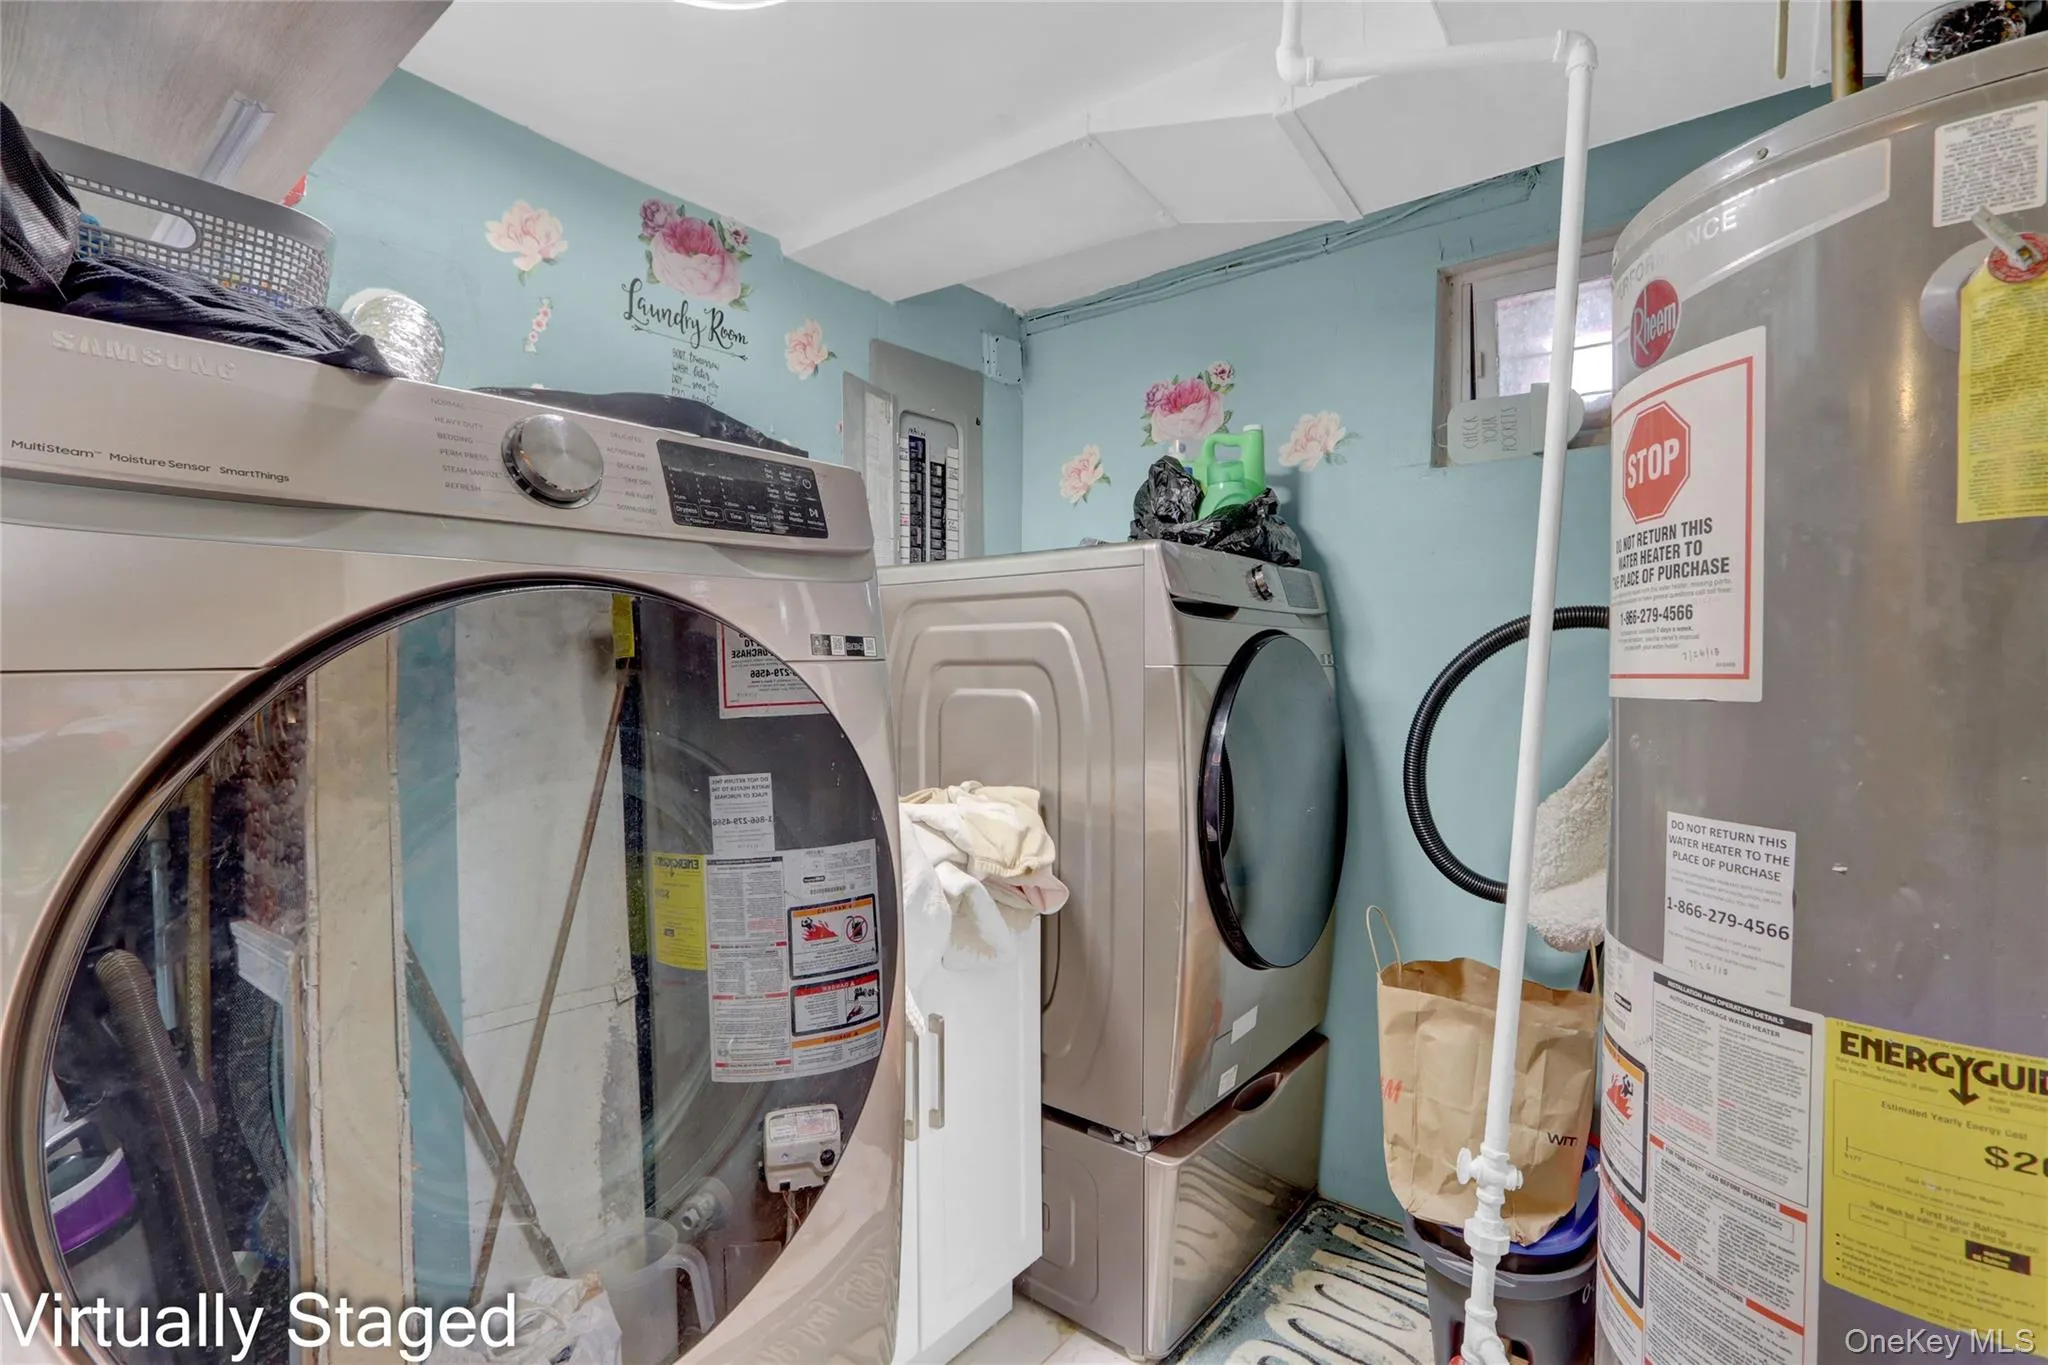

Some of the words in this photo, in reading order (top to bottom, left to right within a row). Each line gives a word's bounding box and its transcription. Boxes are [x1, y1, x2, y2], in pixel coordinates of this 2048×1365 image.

[621, 278, 705, 349] Laundry
[704, 307, 749, 350] Room
[1633, 286, 1677, 354] Rheem
[51, 329, 237, 380] SAMSUNG
[109, 452, 165, 469] Moisture
[168, 458, 211, 473] Sensor
[219, 466, 290, 483] SmartThings
[1627, 438, 1680, 488] STOP
[1623, 533, 1636, 552] NOT
[1637, 523, 1677, 547] RETURN
[1681, 516, 1713, 538] THIS
[1640, 543, 1681, 565] HEATER
[1685, 539, 1703, 557] TO
[1620, 570, 1640, 589] PLACE
[1642, 567, 1654, 584] OF
[1657, 556, 1730, 581] PURCHASE
[1620, 603, 1694, 626] 1-866-279-4566
[1671, 818, 1684, 830] DO
[1686, 822, 1707, 836] NOT
[1709, 826, 1755, 844] RETURN
[1758, 834, 1788, 849] THIS
[1668, 834, 1699, 850] WATER
[1701, 841, 1742, 859] HEATER
[1745, 849, 1761, 861] TO
[1764, 852, 1791, 867] THE
[1672, 849, 1699, 866] PLACE
[1702, 856, 1716, 869] OF
[1718, 858, 1781, 882] PURCHASE
[1666, 895, 1790, 941] 1-866-279-4566
[1700, 1005, 1728, 1021] STORAGE
[1728, 1017, 1751, 1029] WATER
[1752, 1024, 1781, 1038] HEATER
[1717, 999, 1755, 1017] OPERATION
[1755, 1010, 1785, 1025] DETAILS
[1881, 1100, 1928, 1119] Estimated
[1930, 1113, 1963, 1128] Yearly
[1966, 1120, 2001, 1137] Energy
[2004, 1129, 2028, 1141] Cost
[1984, 1144, 2048, 1177] $2
[1920, 1207, 1943, 1221] First
[1973, 1222, 2008, 1238] Rating
